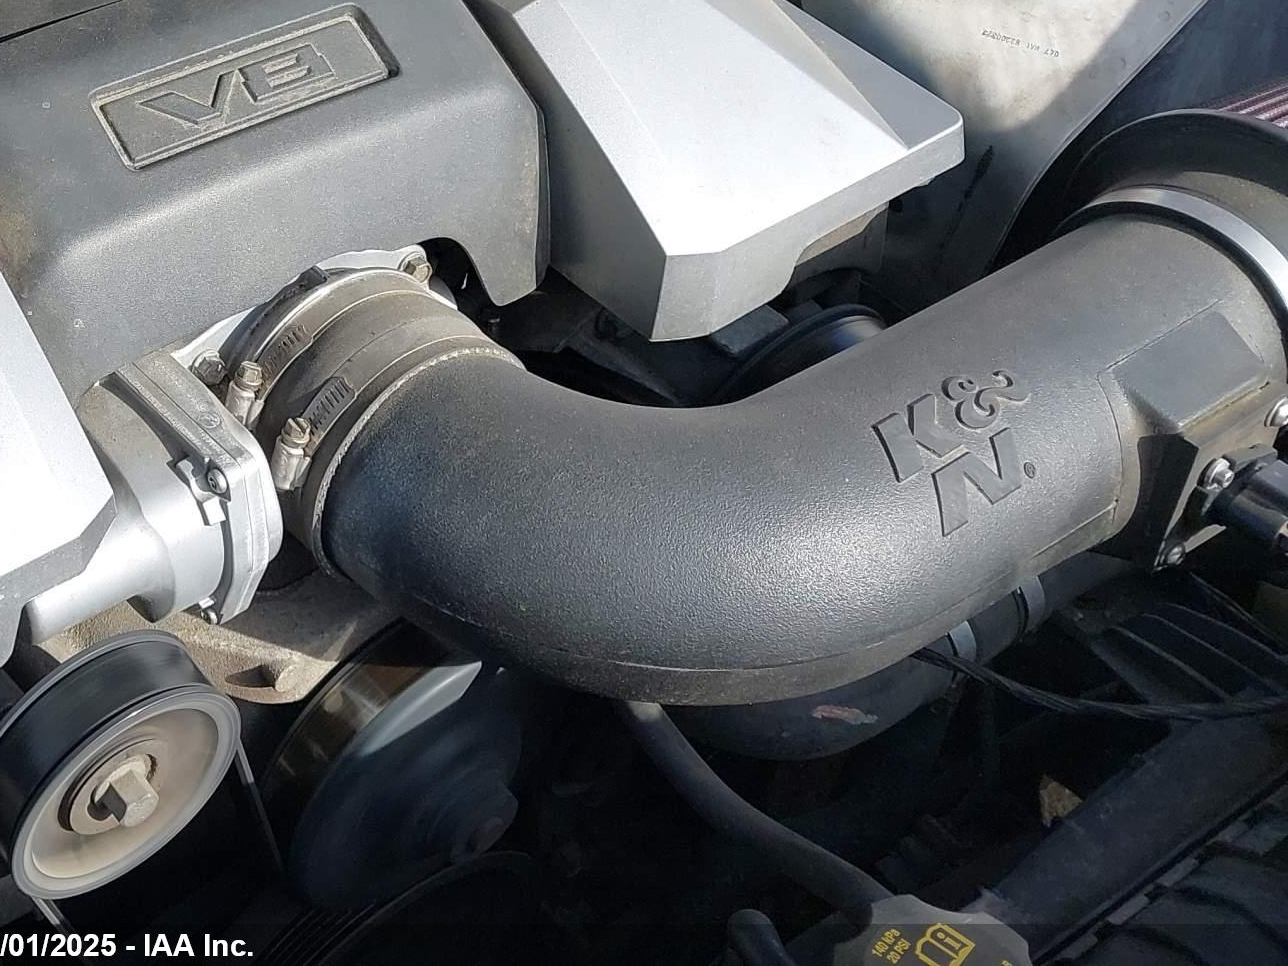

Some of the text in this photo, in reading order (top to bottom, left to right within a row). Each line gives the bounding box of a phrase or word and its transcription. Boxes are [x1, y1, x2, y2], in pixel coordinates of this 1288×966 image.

[135, 42, 337, 129] V8
[871, 941, 889, 958] 140
[886, 938, 912, 964] 20 PSI
